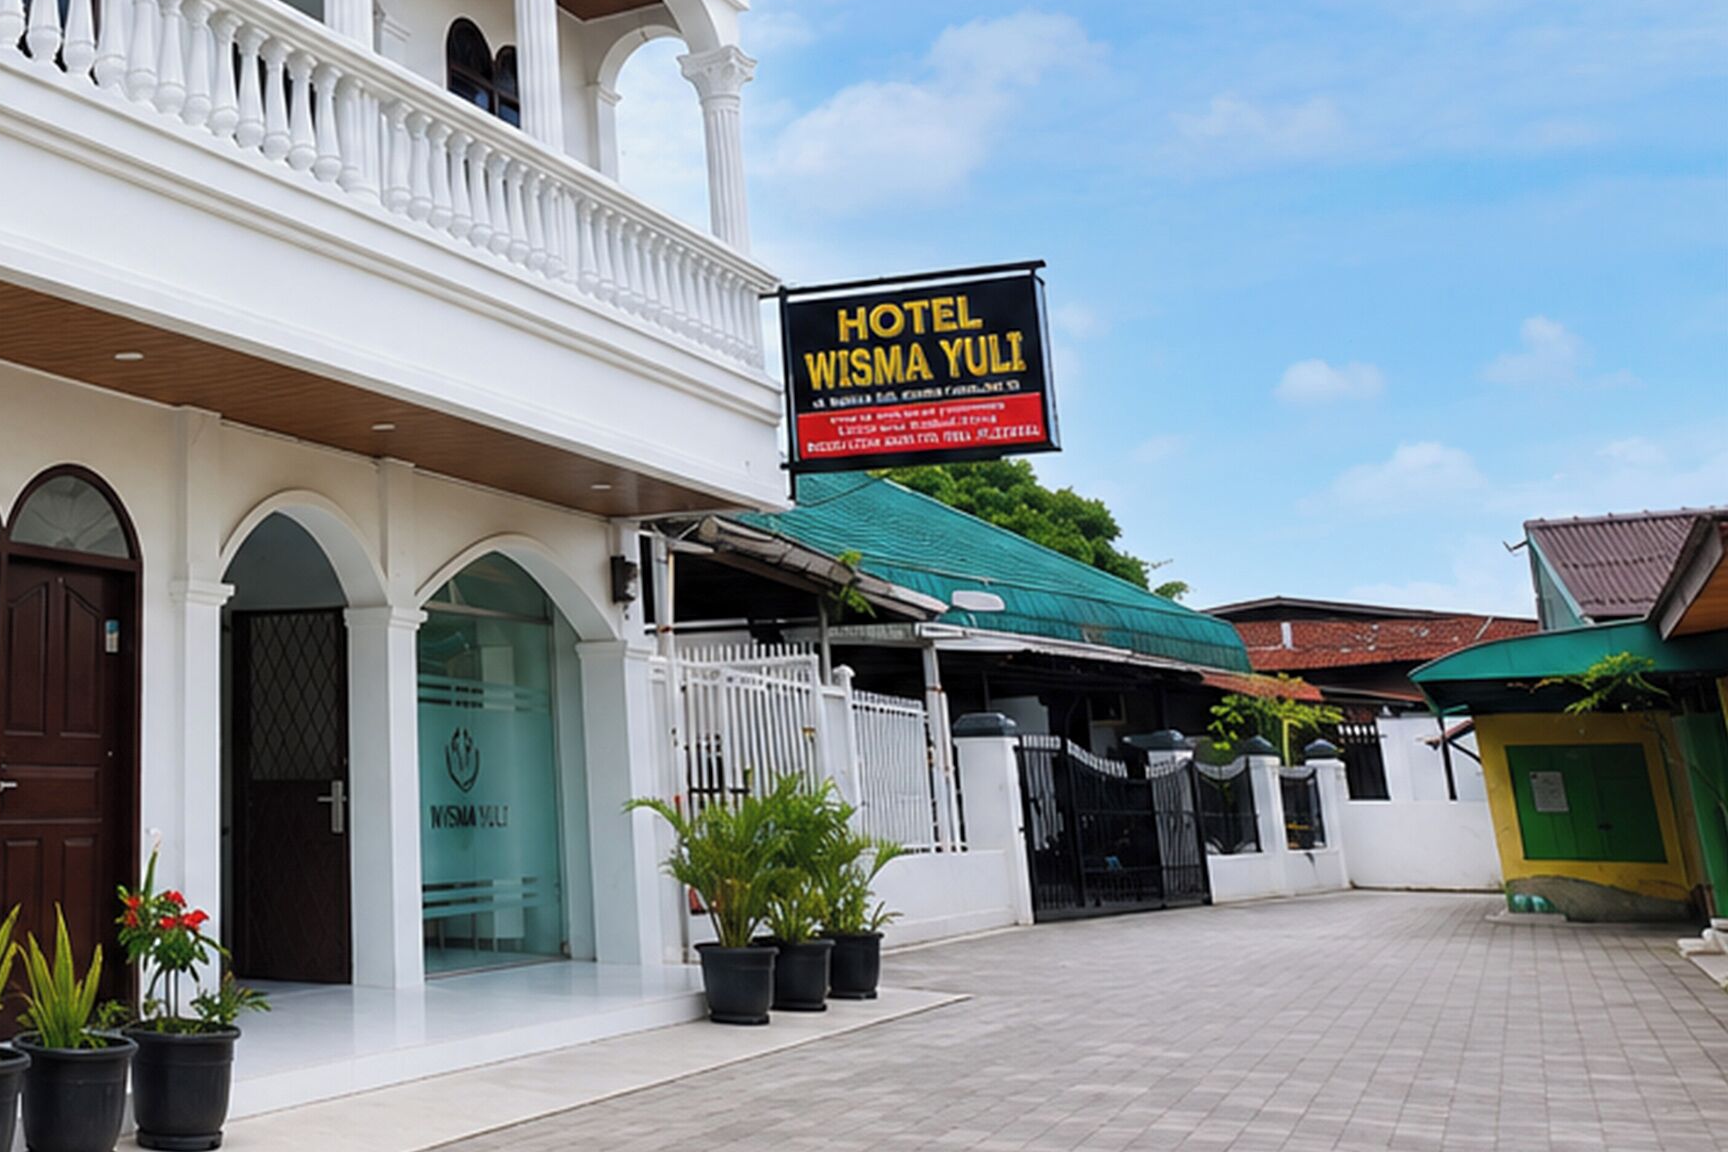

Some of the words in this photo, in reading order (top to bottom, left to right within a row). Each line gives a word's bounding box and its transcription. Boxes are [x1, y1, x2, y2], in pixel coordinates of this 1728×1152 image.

[838, 295, 983, 342] HOTEL
[804, 342, 934, 391] WISMA
[939, 331, 1026, 379] YULI
